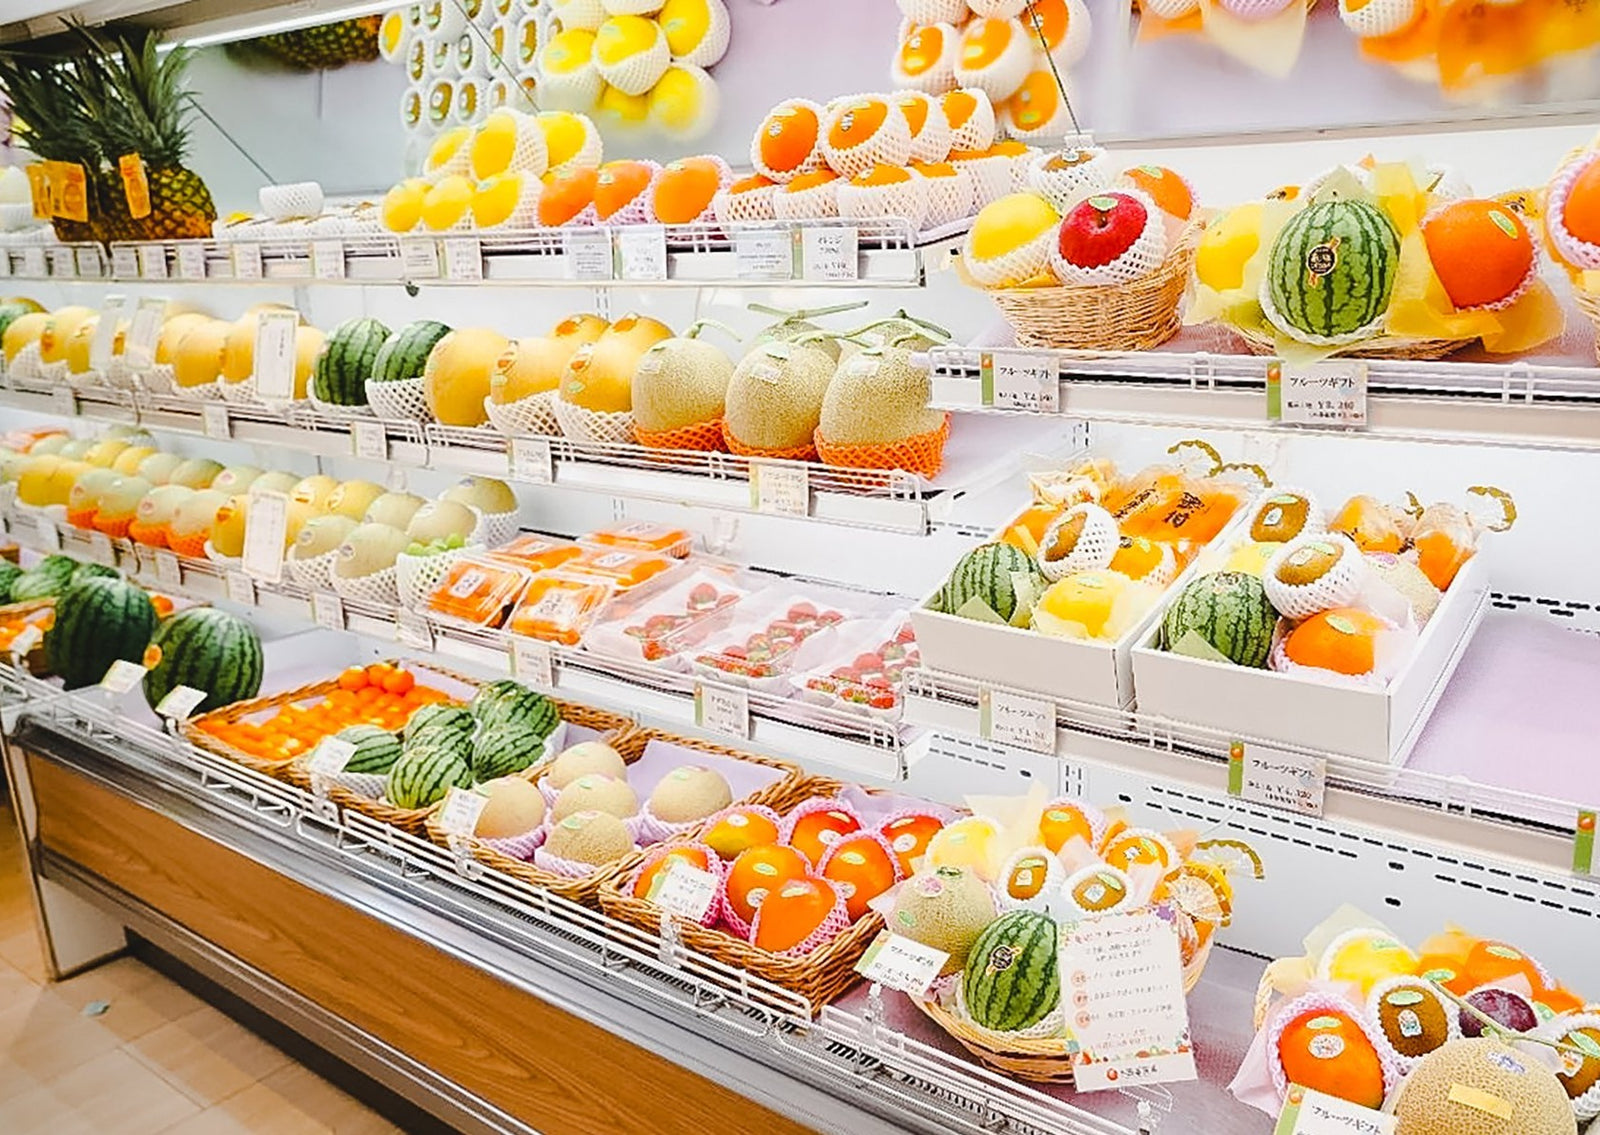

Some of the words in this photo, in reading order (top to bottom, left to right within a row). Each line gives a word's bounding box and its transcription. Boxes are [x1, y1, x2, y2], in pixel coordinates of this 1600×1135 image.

[999, 366, 1053, 380] フルーツギフト
[1289, 376, 1356, 389] フルーツギフト
[1252, 759, 1316, 778] フルーツギフト
